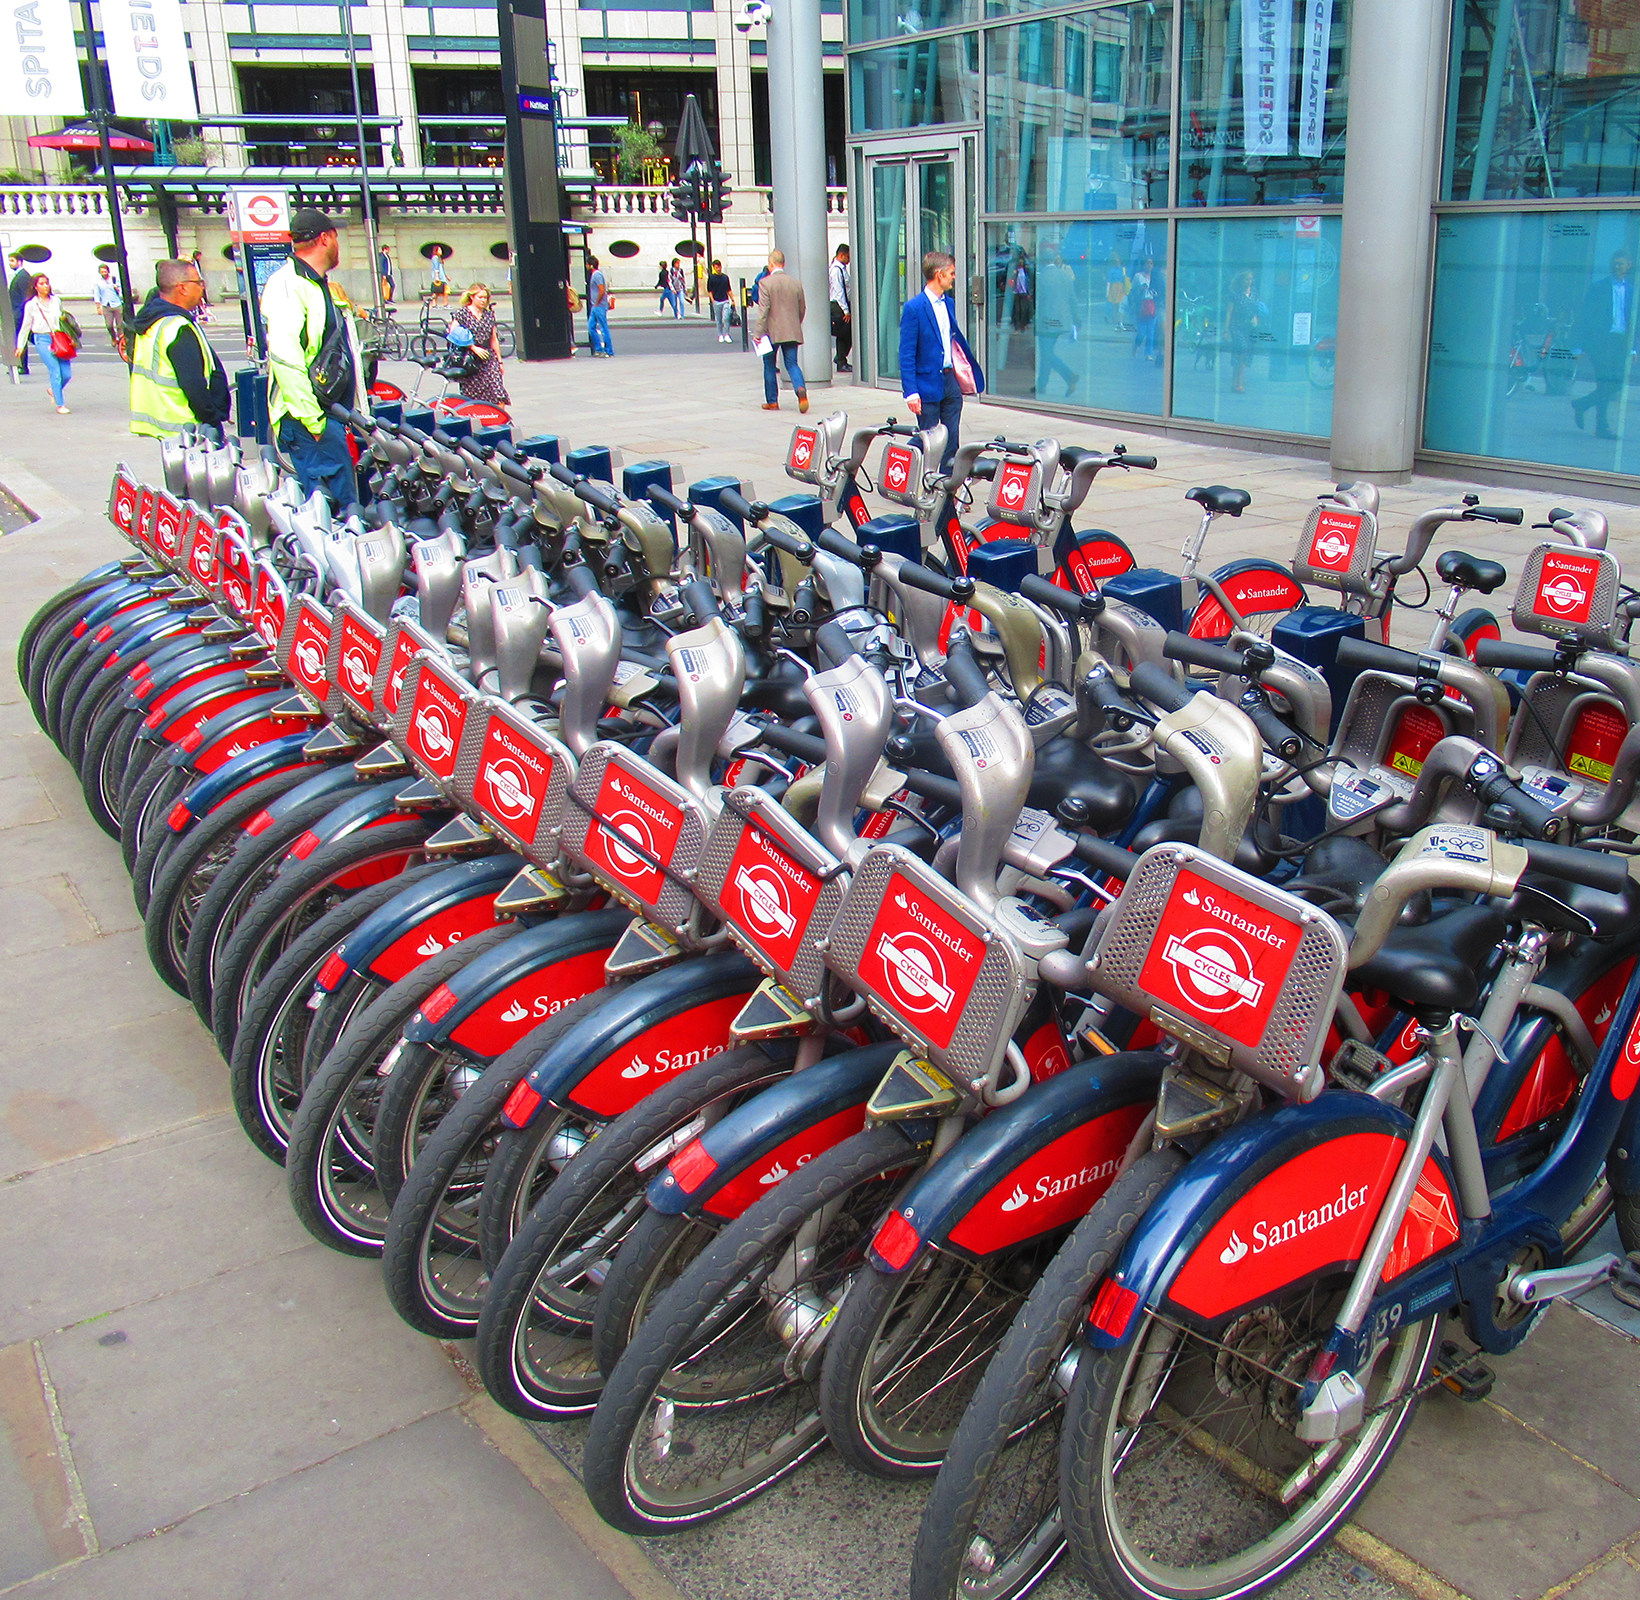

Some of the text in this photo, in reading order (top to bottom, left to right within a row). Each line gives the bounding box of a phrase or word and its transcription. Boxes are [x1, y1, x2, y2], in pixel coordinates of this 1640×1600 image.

[1327, 518, 1357, 530] Santander
[1088, 554, 1122, 567] Santander
[1556, 560, 1594, 575] Santander
[1247, 585, 1289, 599] Santander
[1555, 590, 1572, 598] CYCLES
[352, 629, 378, 657] Santander
[429, 679, 463, 719] Santander
[427, 724, 442, 742] CYCLES
[502, 735, 546, 775] Santander
[500, 779, 519, 799] CYCLES
[1336, 792, 1365, 808] CAUTION
[622, 784, 675, 831] Santander
[761, 837, 813, 894] Santander
[754, 889, 776, 915] CYCLES
[908, 901, 973, 964] Santander
[1200, 895, 1286, 950] Santander
[900, 958, 929, 987] CYCLES
[1193, 956, 1232, 984] CYCLES
[1252, 1183, 1369, 1255] Santander
